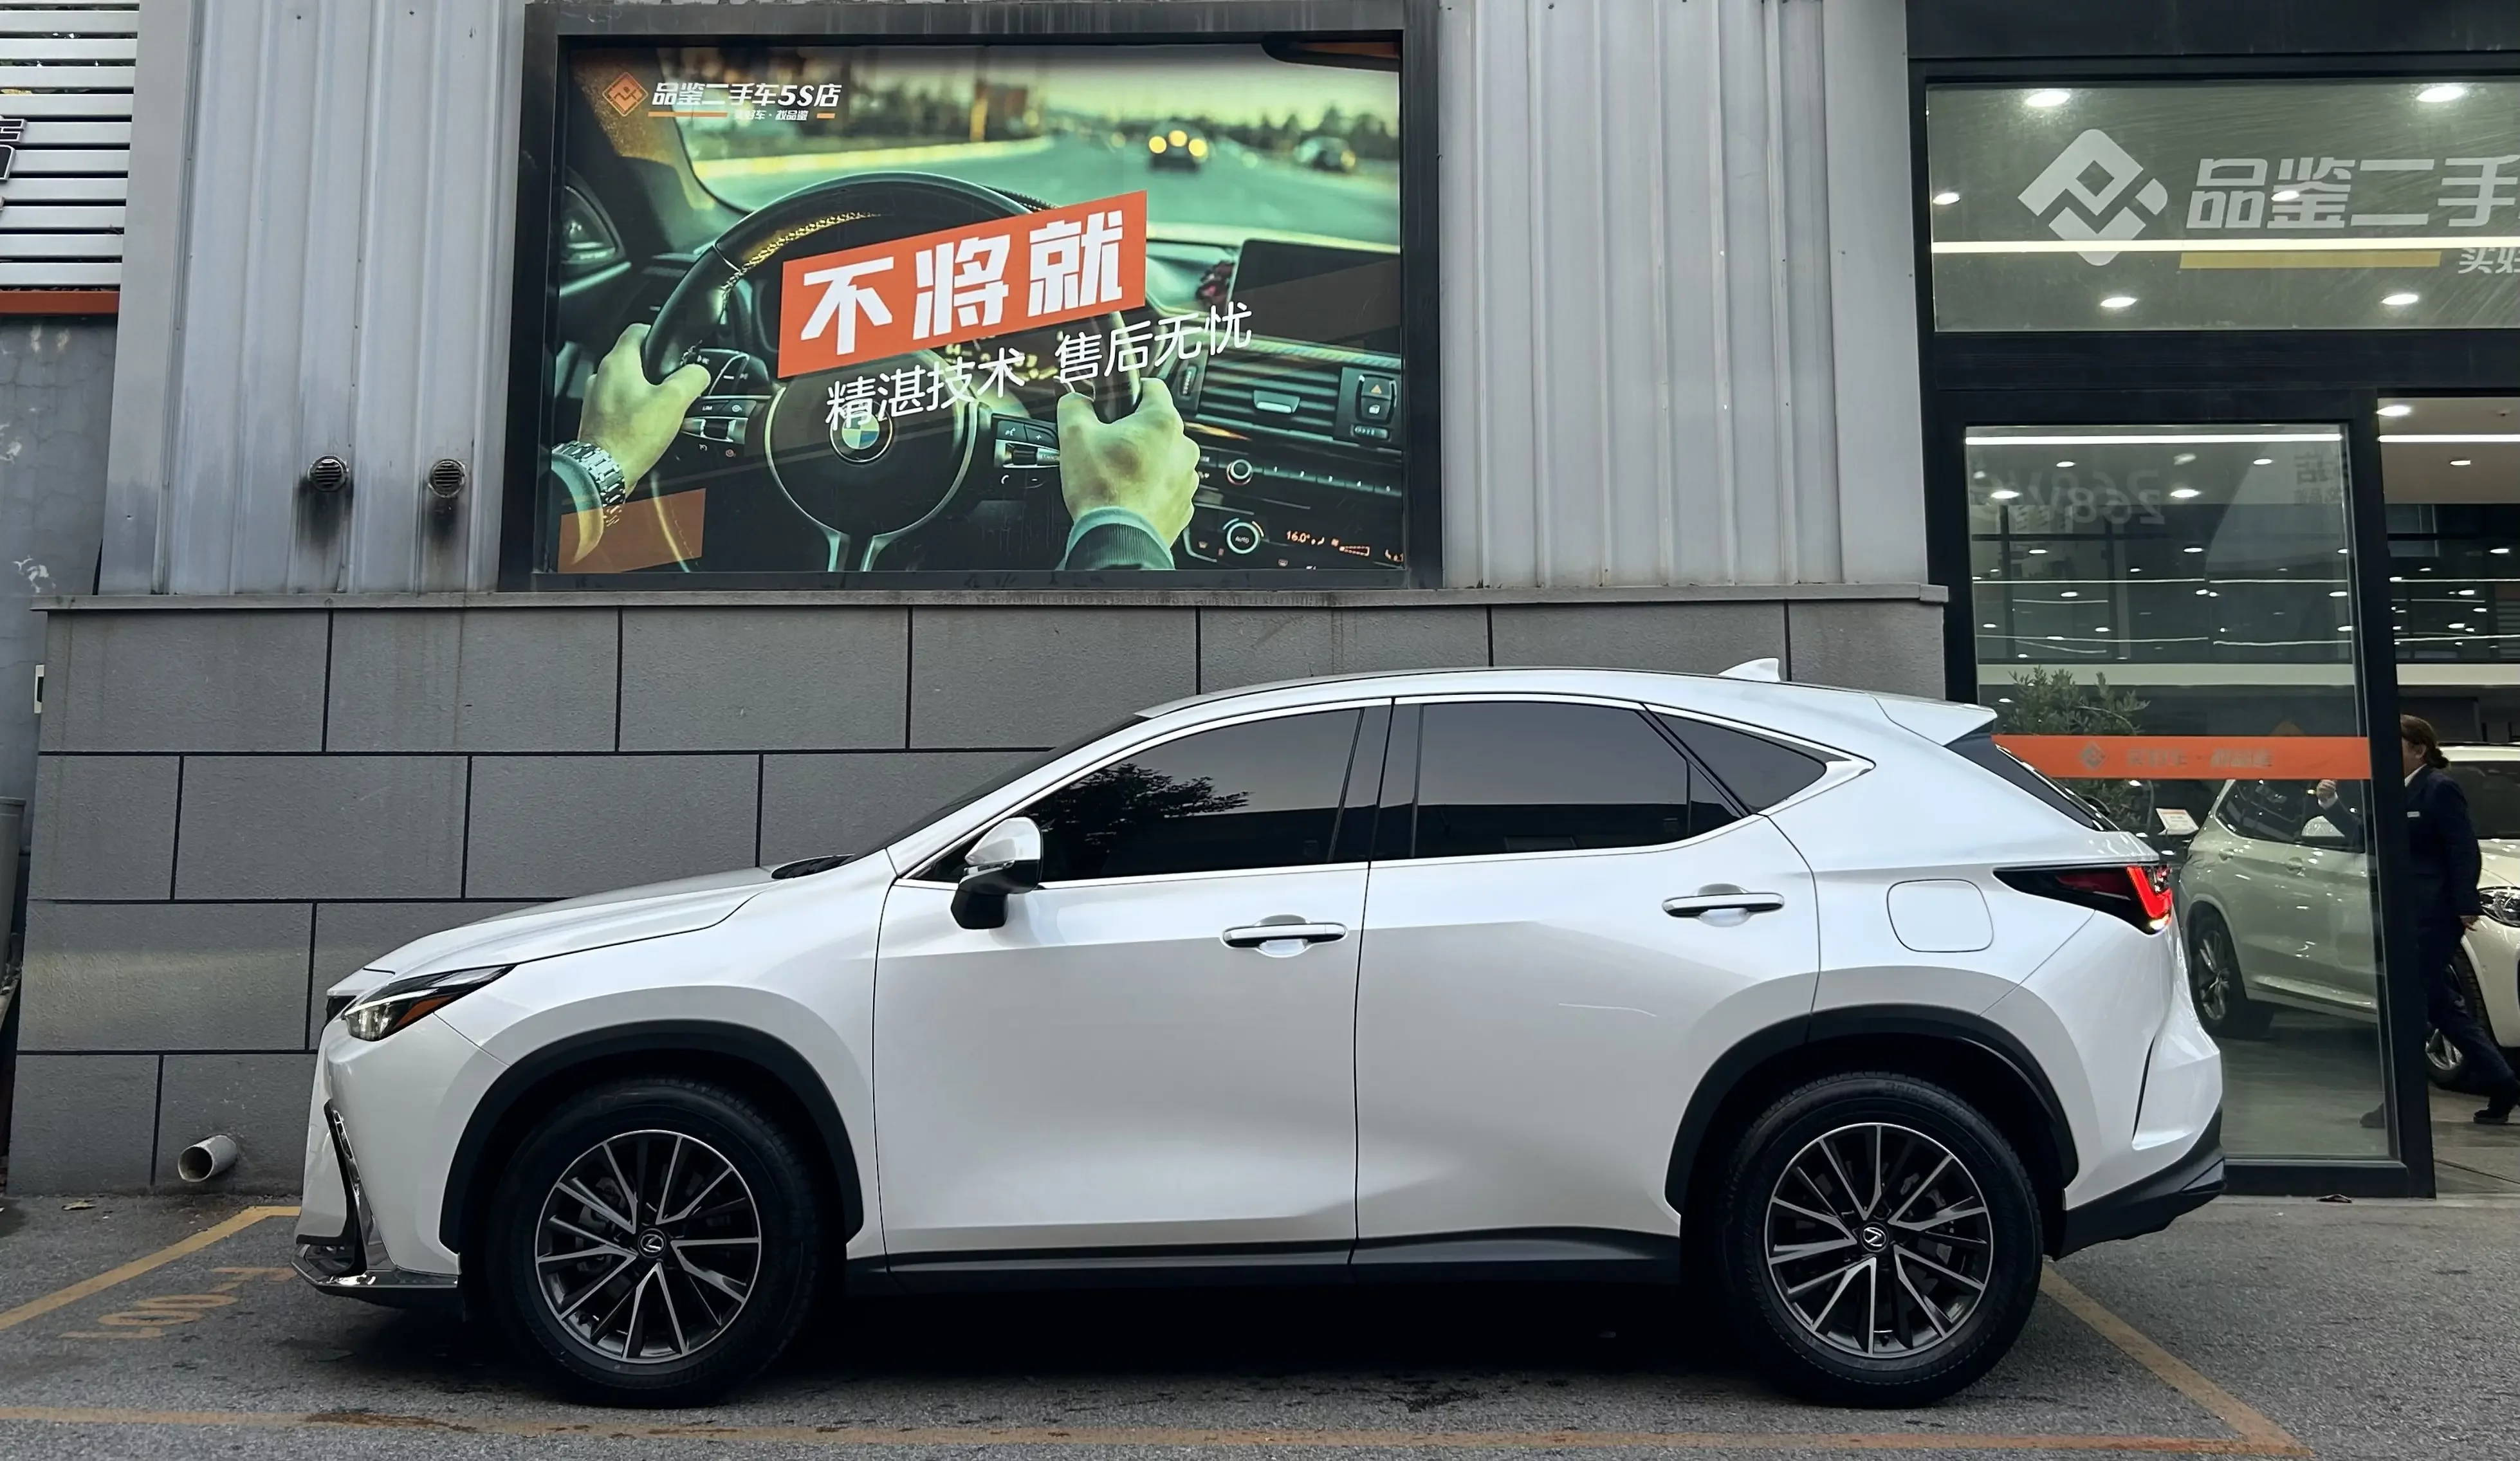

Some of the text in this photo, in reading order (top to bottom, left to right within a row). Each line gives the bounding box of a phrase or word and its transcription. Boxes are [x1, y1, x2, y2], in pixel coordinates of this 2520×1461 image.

[651, 82, 842, 107] 品鉴二手车5S店
[2186, 154, 2520, 230] 品鉴二手
[801, 210, 1123, 355] 不将就
[825, 302, 1252, 430] 精湛技术 售后无忧
